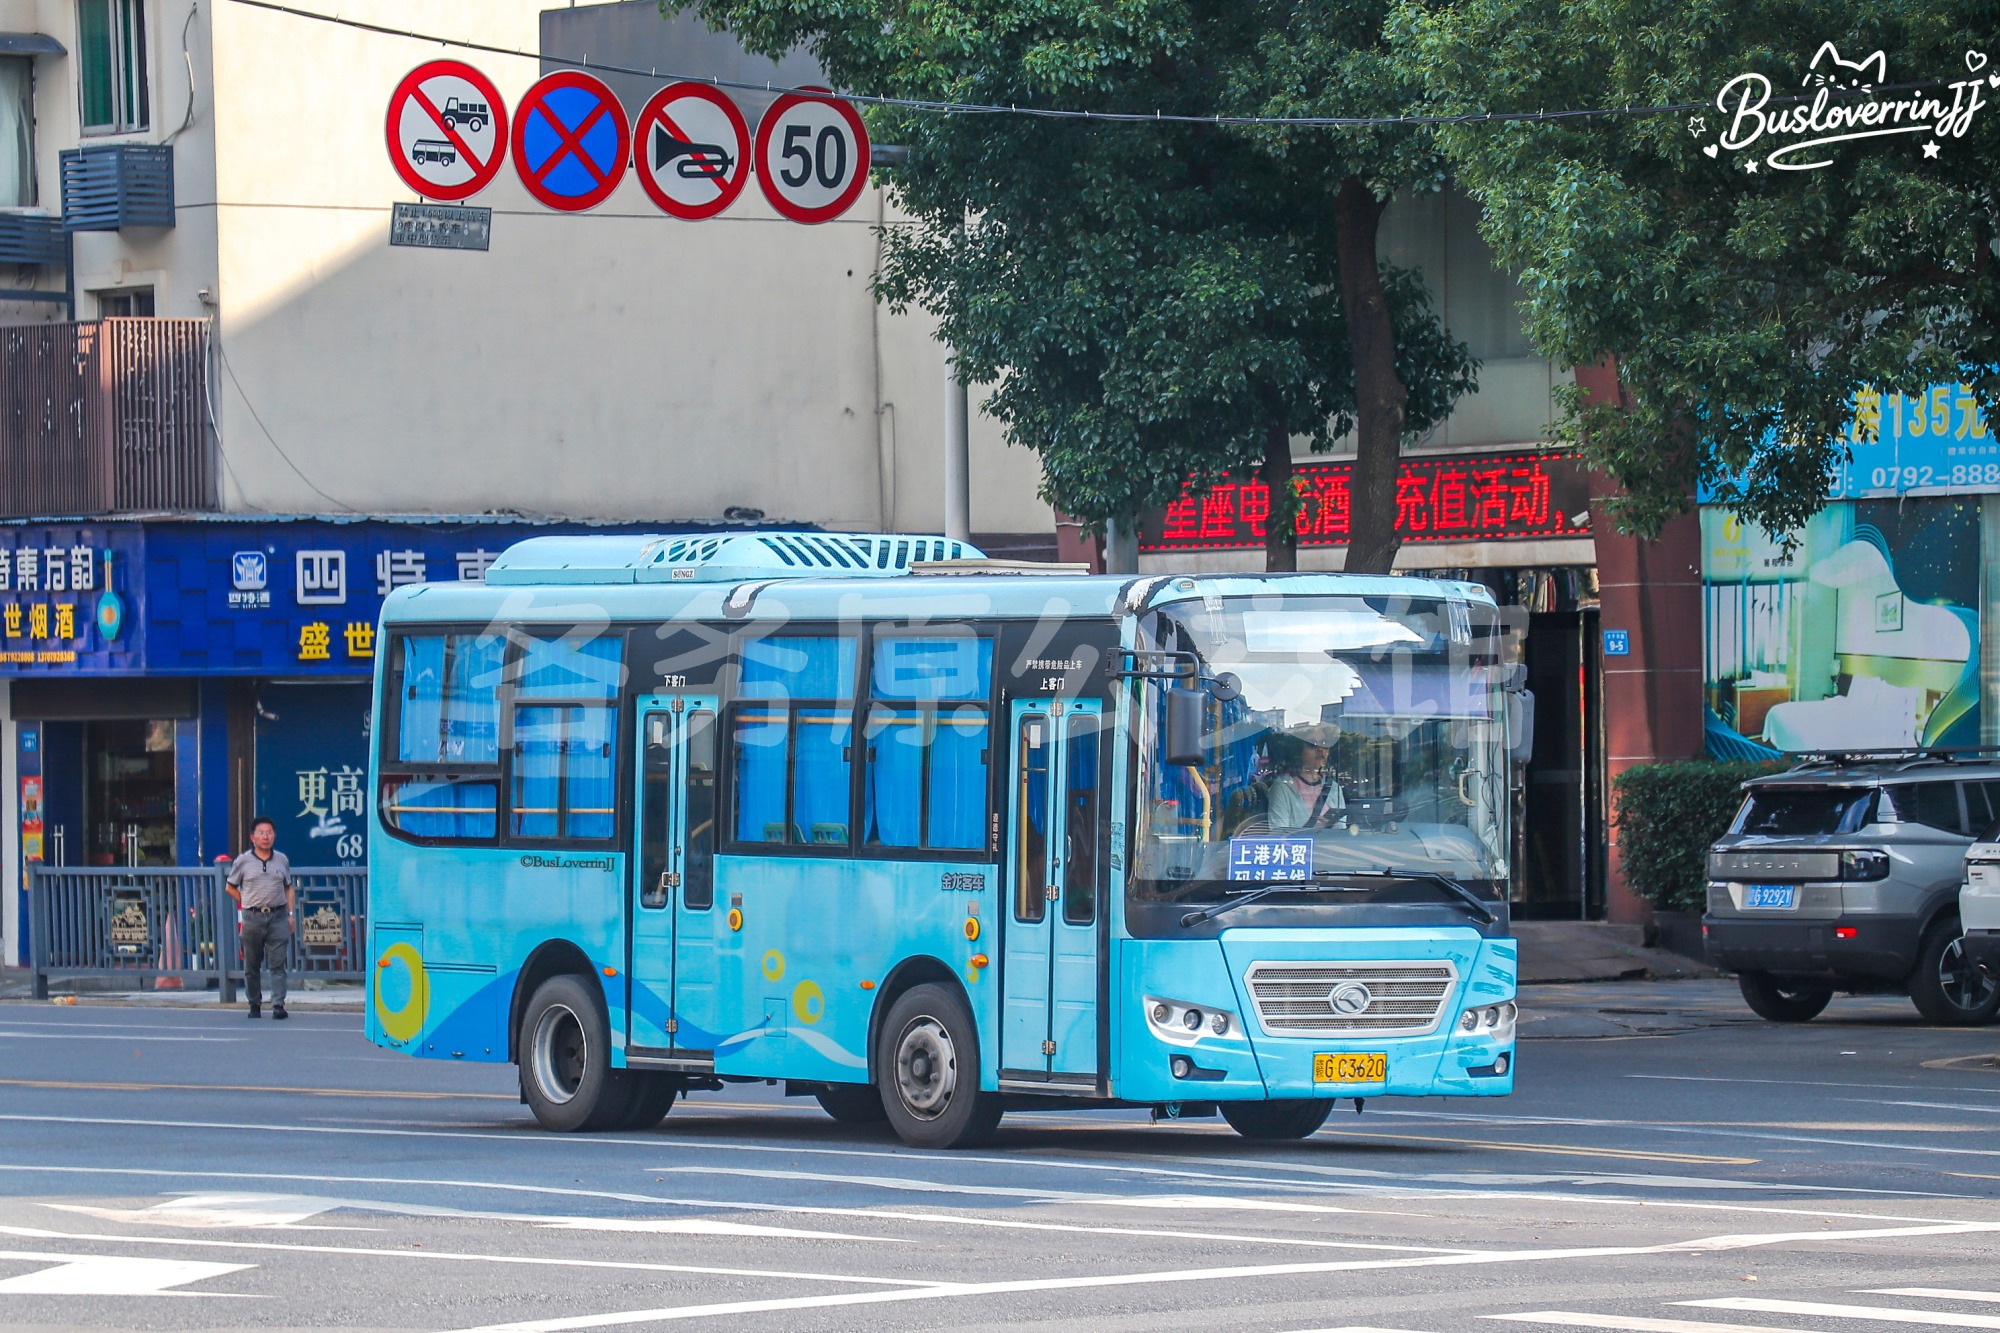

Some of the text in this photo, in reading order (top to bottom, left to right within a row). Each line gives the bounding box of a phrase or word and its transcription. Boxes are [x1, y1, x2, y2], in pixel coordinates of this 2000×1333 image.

[779, 124, 846, 188] 50
[4, 602, 74, 640] 世烟酒
[298, 621, 374, 660] 盛世
[664, 674, 686, 688] 下客门
[1040, 677, 1065, 691] 上客门
[296, 765, 364, 818] 更高
[336, 834, 363, 858] 68
[1235, 844, 1307, 866] 上港外贸
[941, 872, 985, 892] 金龙客车
